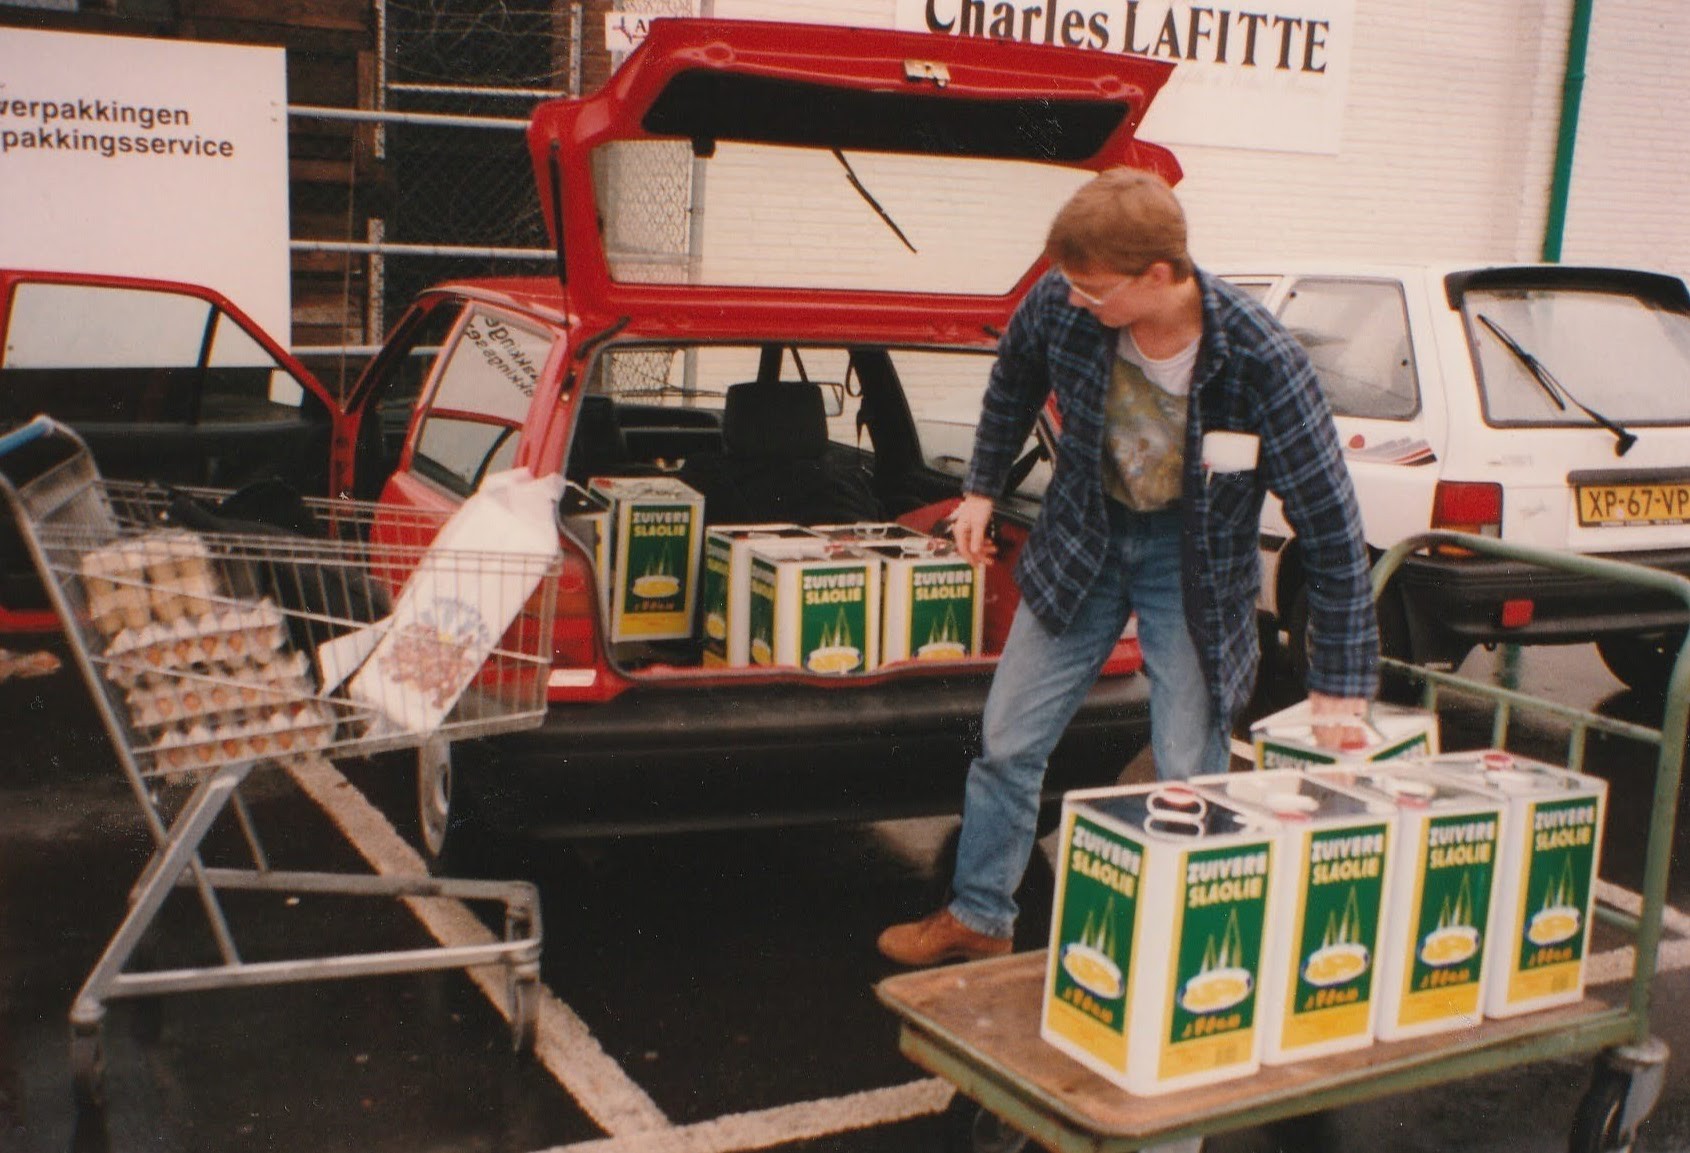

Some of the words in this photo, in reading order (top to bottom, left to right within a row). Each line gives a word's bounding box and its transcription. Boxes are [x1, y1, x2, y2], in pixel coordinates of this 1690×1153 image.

[925, 0, 1109, 50] Charles
[1122, 1, 1330, 74] LAFITTE
[2, 127, 235, 158] pakkingsservice
[1588, 488, 1690, 519] XP-67-VP
[1429, 820, 1496, 847] ZUIVERE
[1534, 805, 1595, 831] ZUIVERE
[1072, 825, 1141, 877] ZUIVERE
[1311, 832, 1384, 864] ZUIVERE
[1535, 825, 1592, 852] SLAOLIE
[1187, 852, 1268, 885] ZUIVERE
[1430, 842, 1492, 869] SLAOLIE
[1071, 850, 1136, 899] SLAOLIE
[1312, 857, 1380, 886] SLAOLIE
[1188, 876, 1264, 909] SLAOLIE
